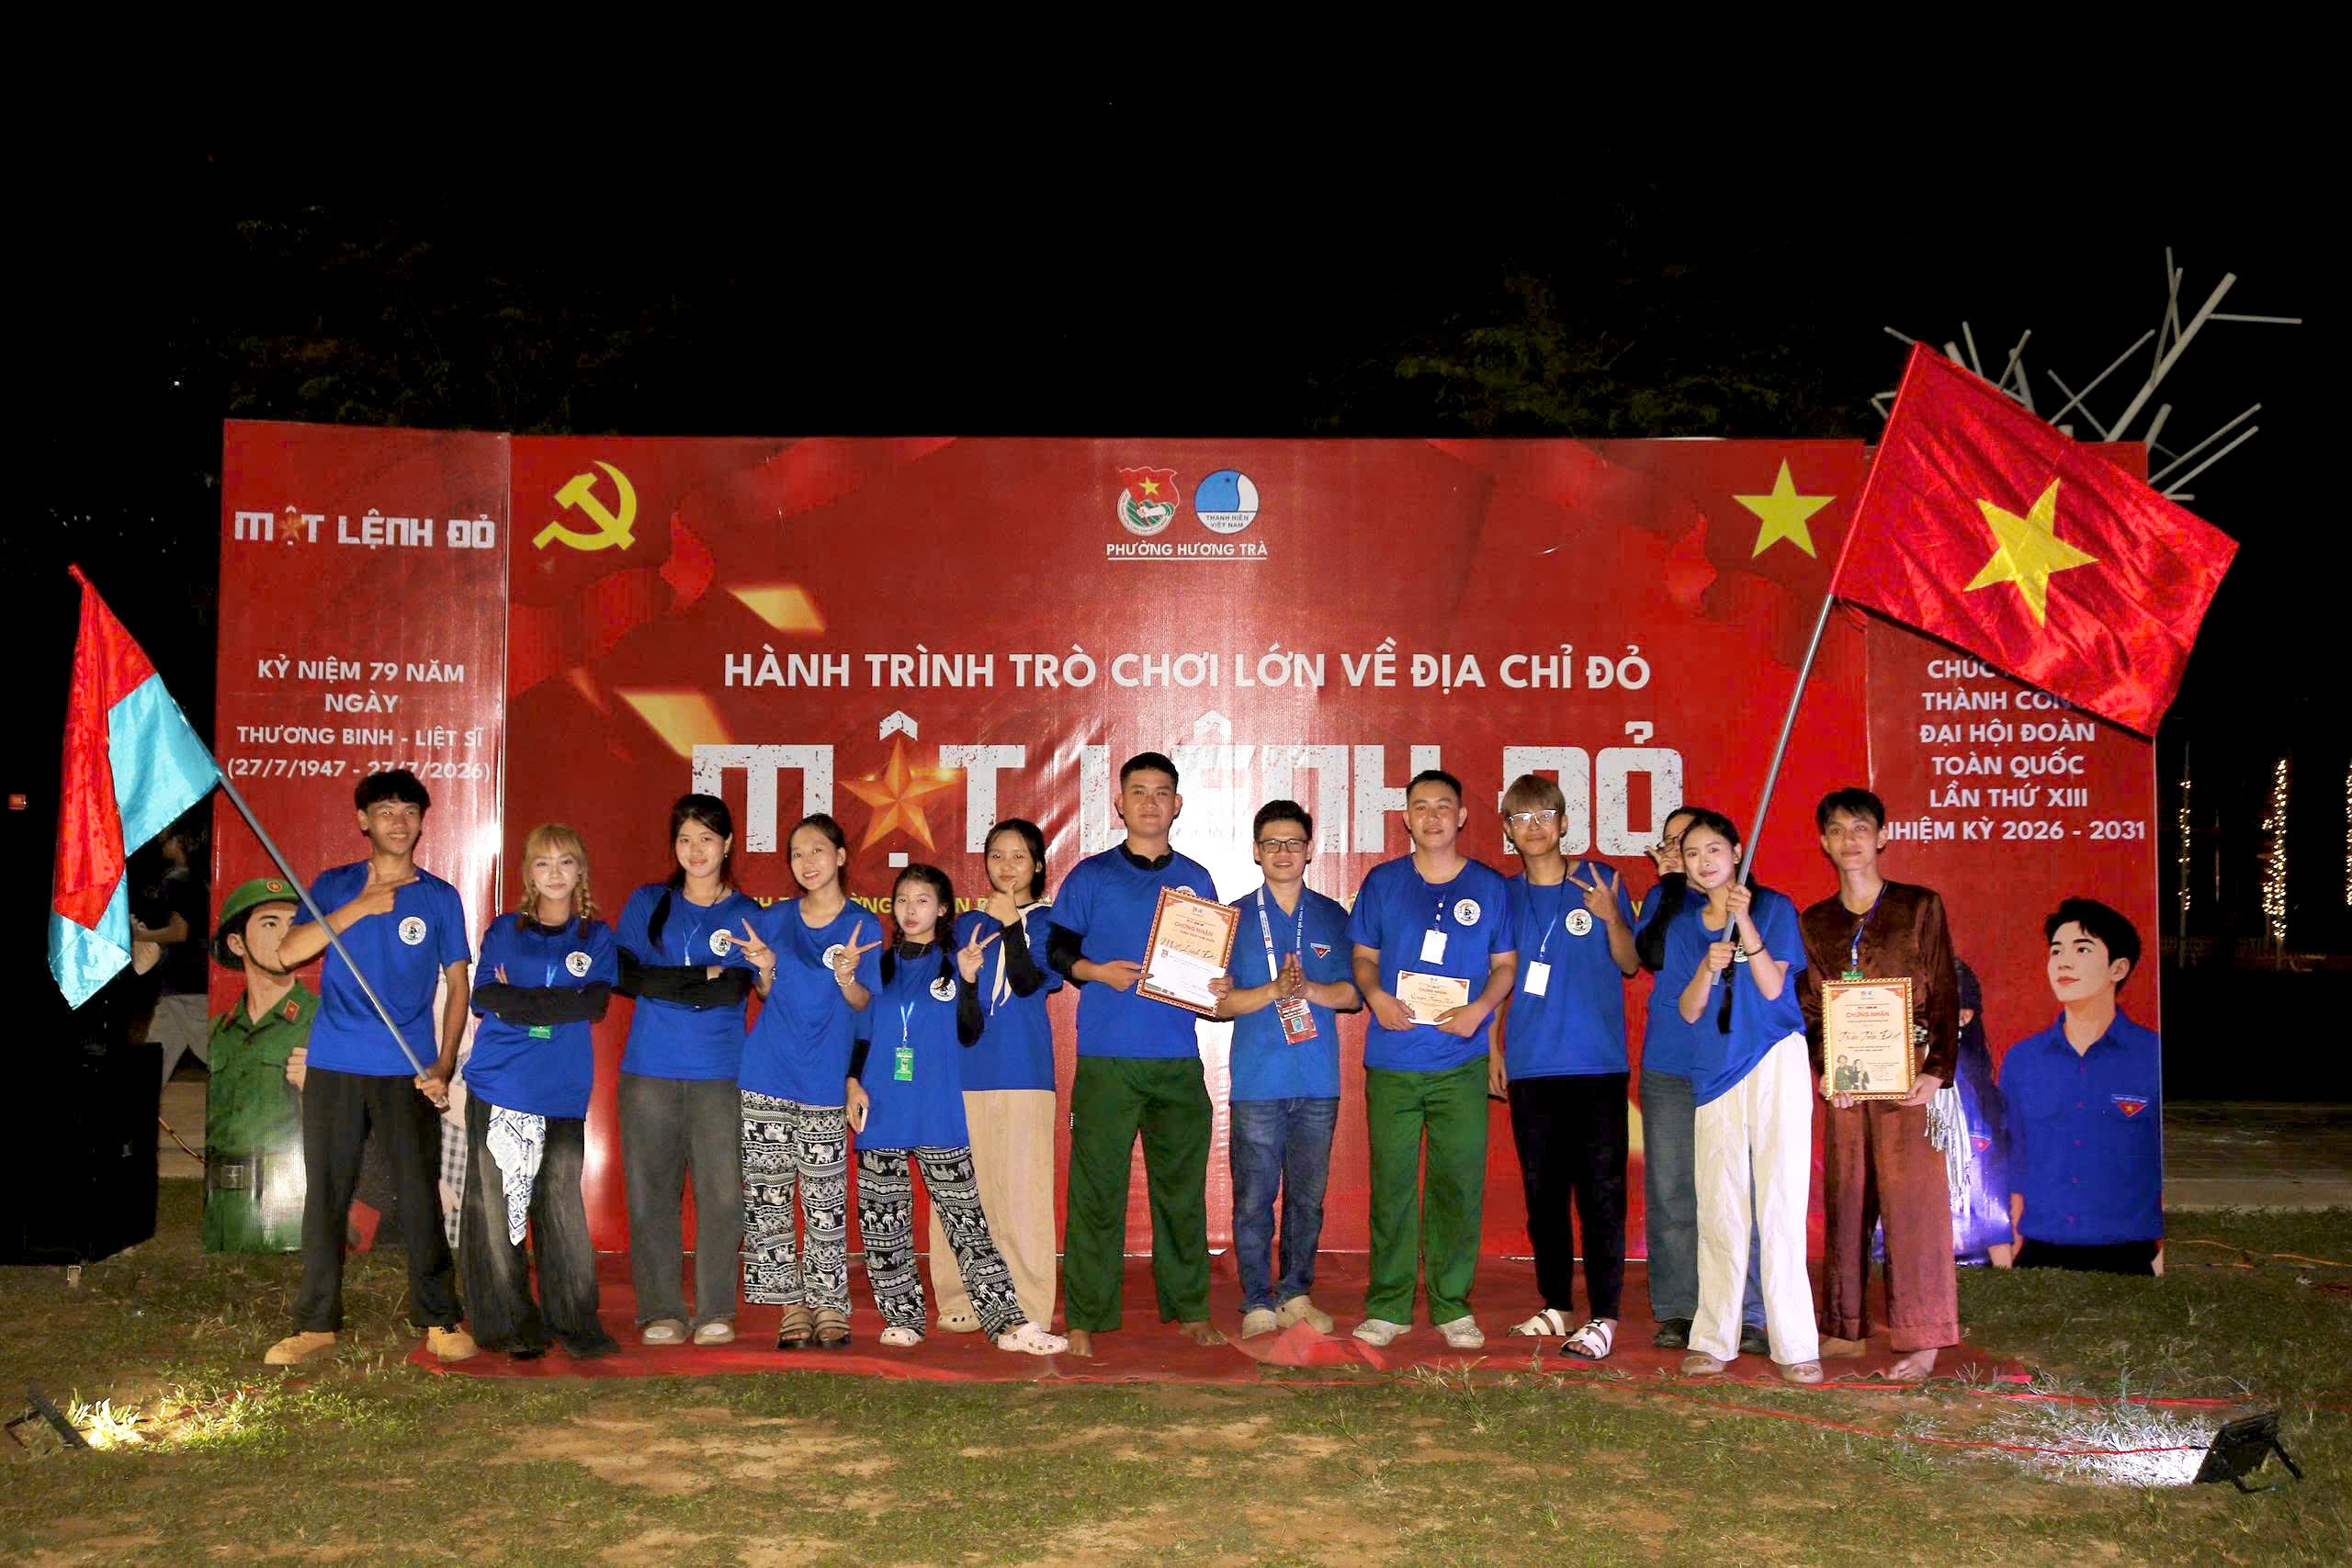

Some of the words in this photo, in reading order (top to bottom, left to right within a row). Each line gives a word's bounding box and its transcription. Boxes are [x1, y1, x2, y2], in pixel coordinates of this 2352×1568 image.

[338, 508, 434, 549] LỆNH
[447, 514, 495, 548] ĐỎ
[1106, 540, 1173, 556] PHƯỜNG
[1177, 541, 1236, 556] HƯƠNG
[1238, 540, 1268, 556] TRÀ
[257, 653, 290, 680] KỶ
[299, 656, 361, 684] NIỆM
[369, 661, 399, 682] 79
[406, 660, 465, 682] NĂM
[723, 643, 850, 687] HÀNH
[865, 643, 995, 688] TRÌNH
[1009, 643, 1097, 688] TRÒ
[1111, 652, 1219, 688] CHƠI
[1234, 642, 1326, 688] LỚN
[1340, 636, 1397, 688] VỀ
[1410, 653, 1487, 695] ĐỊA
[1498, 643, 1574, 690] CHỈ
[1586, 645, 1652, 690] ĐỎ
[324, 689, 399, 714] NGÀY
[1921, 687, 2007, 712] THÀNH
[236, 726, 335, 745] THƯƠNG
[342, 728, 394, 746] BINH
[415, 725, 458, 750] LIỆT
[464, 727, 484, 748] SĨ
[1919, 723, 1962, 747] ĐẠI
[1969, 717, 2013, 747] HỘI
[2020, 717, 2096, 742] ĐOÀN
[227, 758, 346, 779] (27/7/1947
[1931, 750, 2002, 775] TOÀN
[2009, 746, 2085, 779] QUỐC
[1497, 720, 1684, 857] ĐỎ
[1929, 780, 1980, 807] LẦN
[1987, 783, 2041, 807] THỨ
[2047, 788, 2088, 807] XIII
[1962, 816, 1996, 840] KỲ
[2002, 820, 2065, 840] 2026
[2089, 820, 2146, 840] 2031
